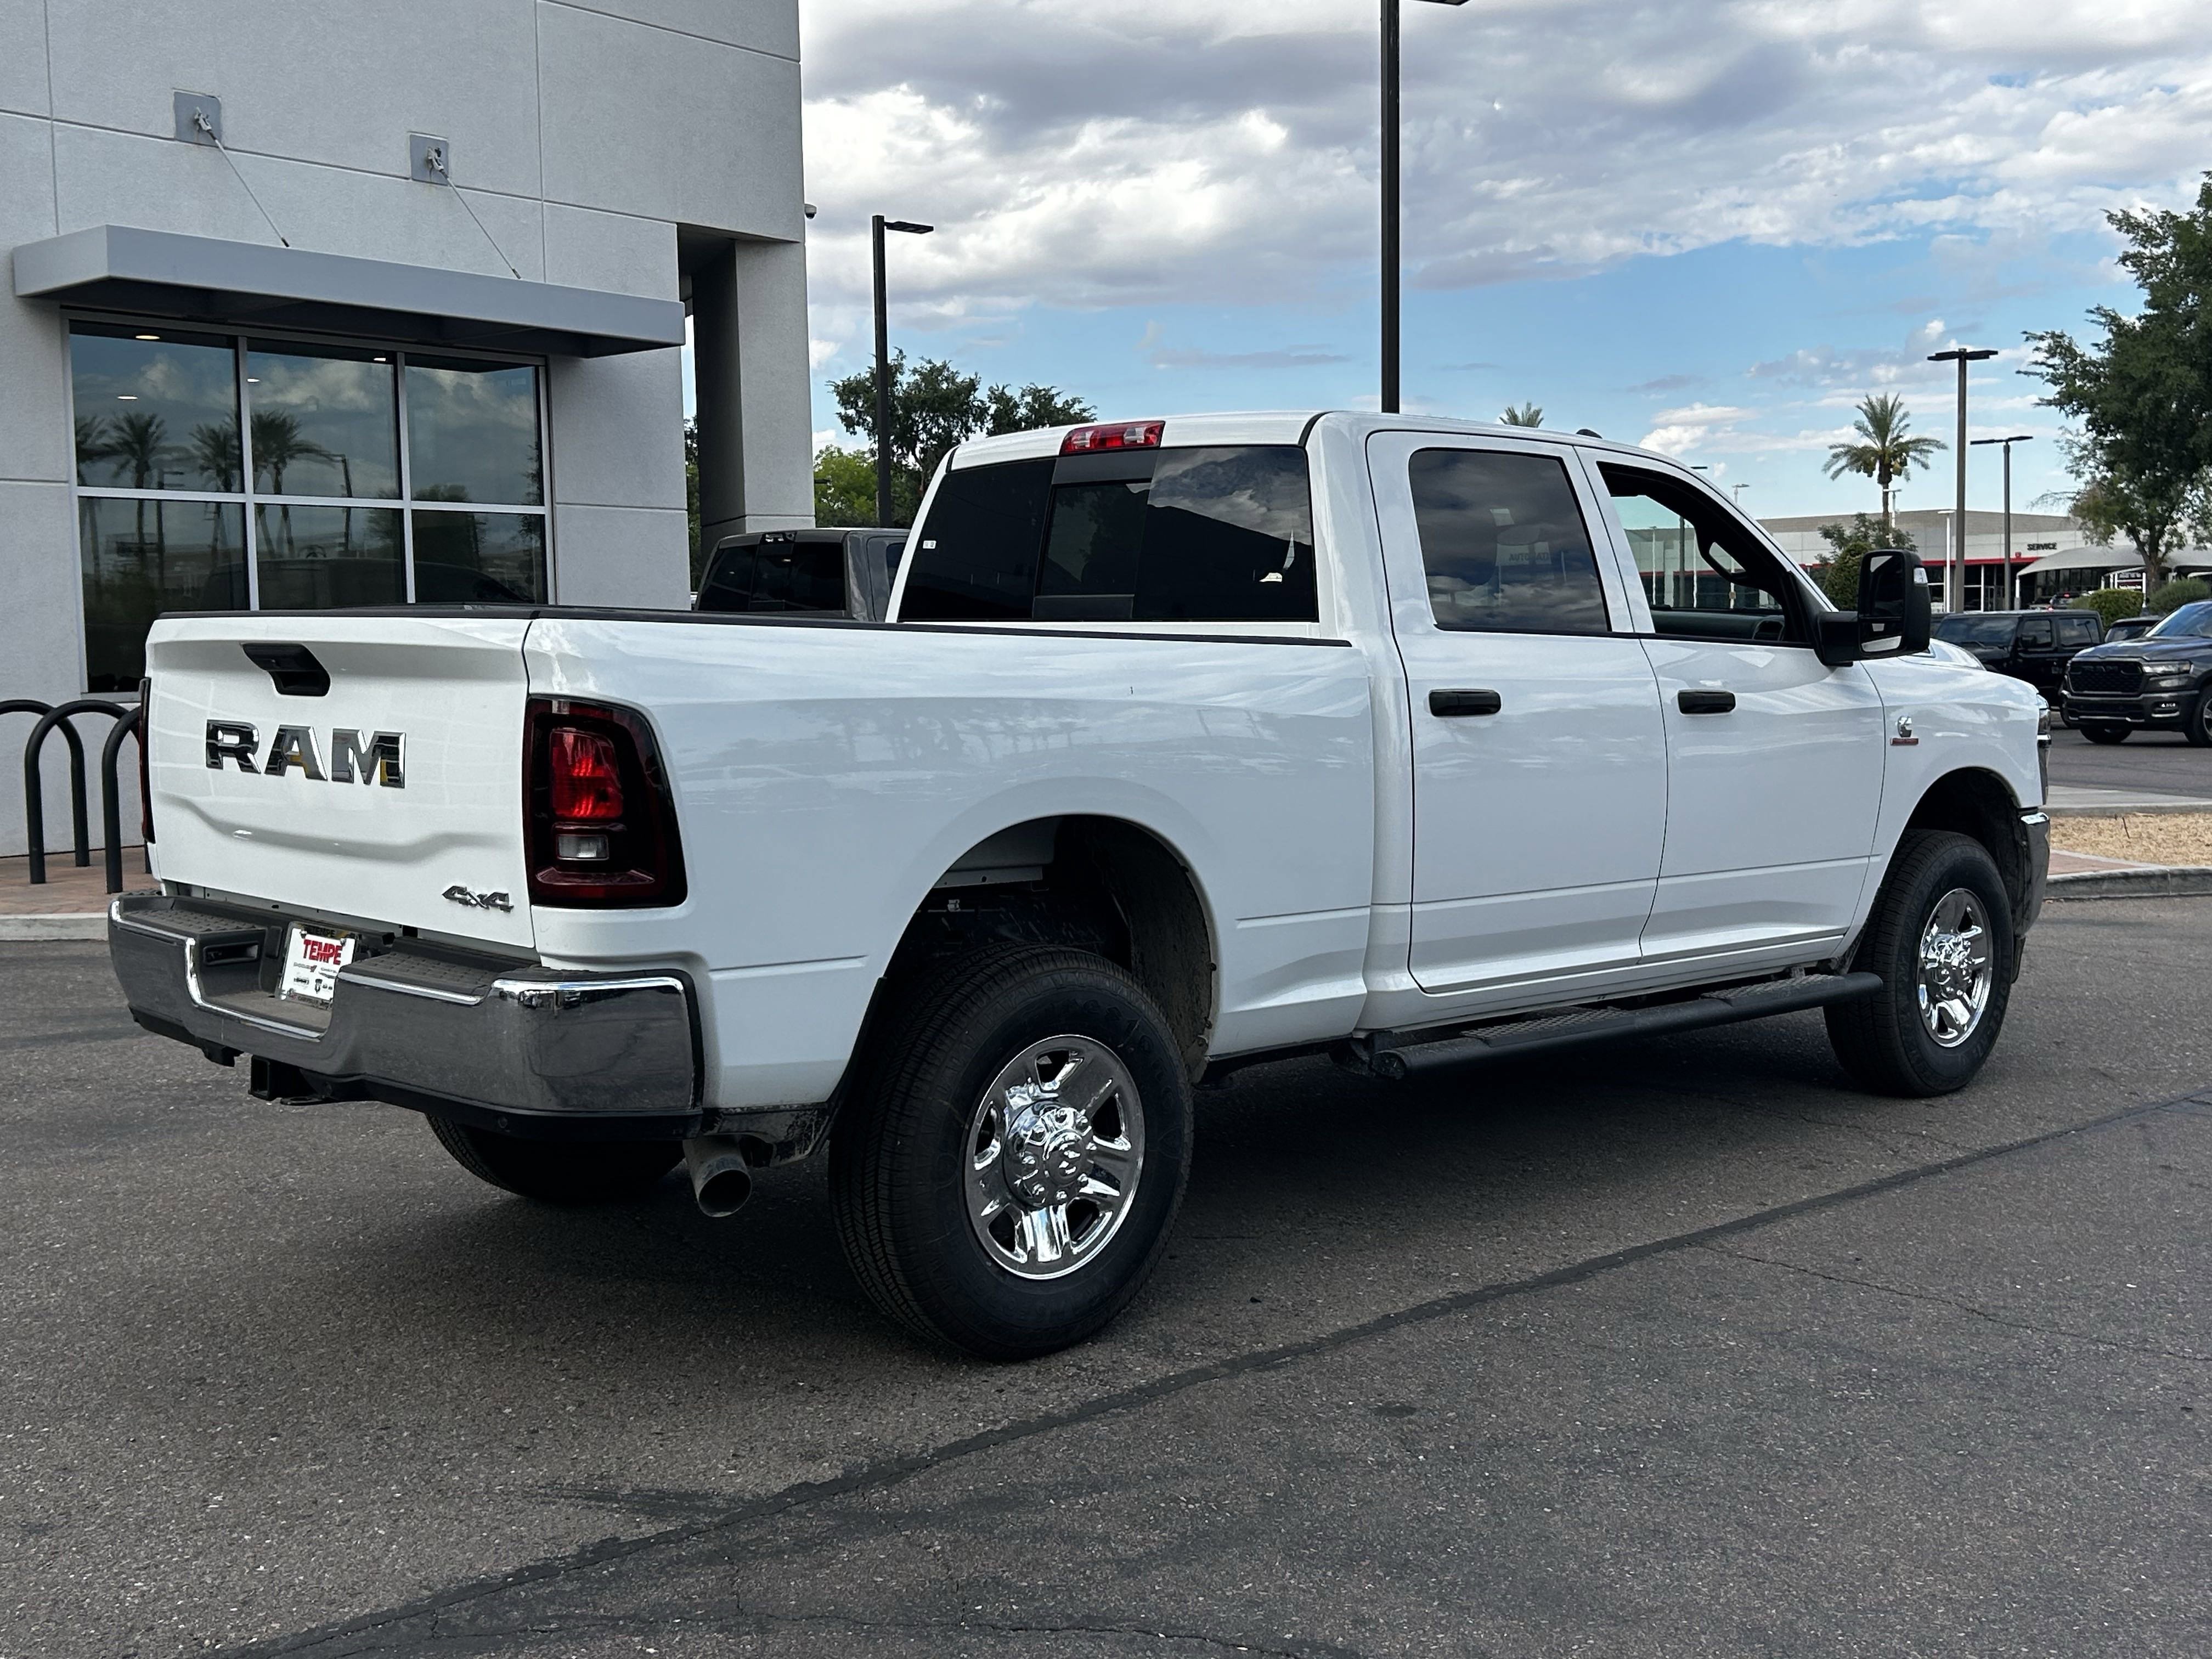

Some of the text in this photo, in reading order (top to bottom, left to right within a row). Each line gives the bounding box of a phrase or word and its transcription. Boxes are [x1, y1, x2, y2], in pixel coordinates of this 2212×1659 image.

[2027, 543, 2057, 551] SERVICE
[206, 719, 407, 788] RAM
[442, 885, 514, 913] 4x4
[303, 939, 343, 966] TEMPE
